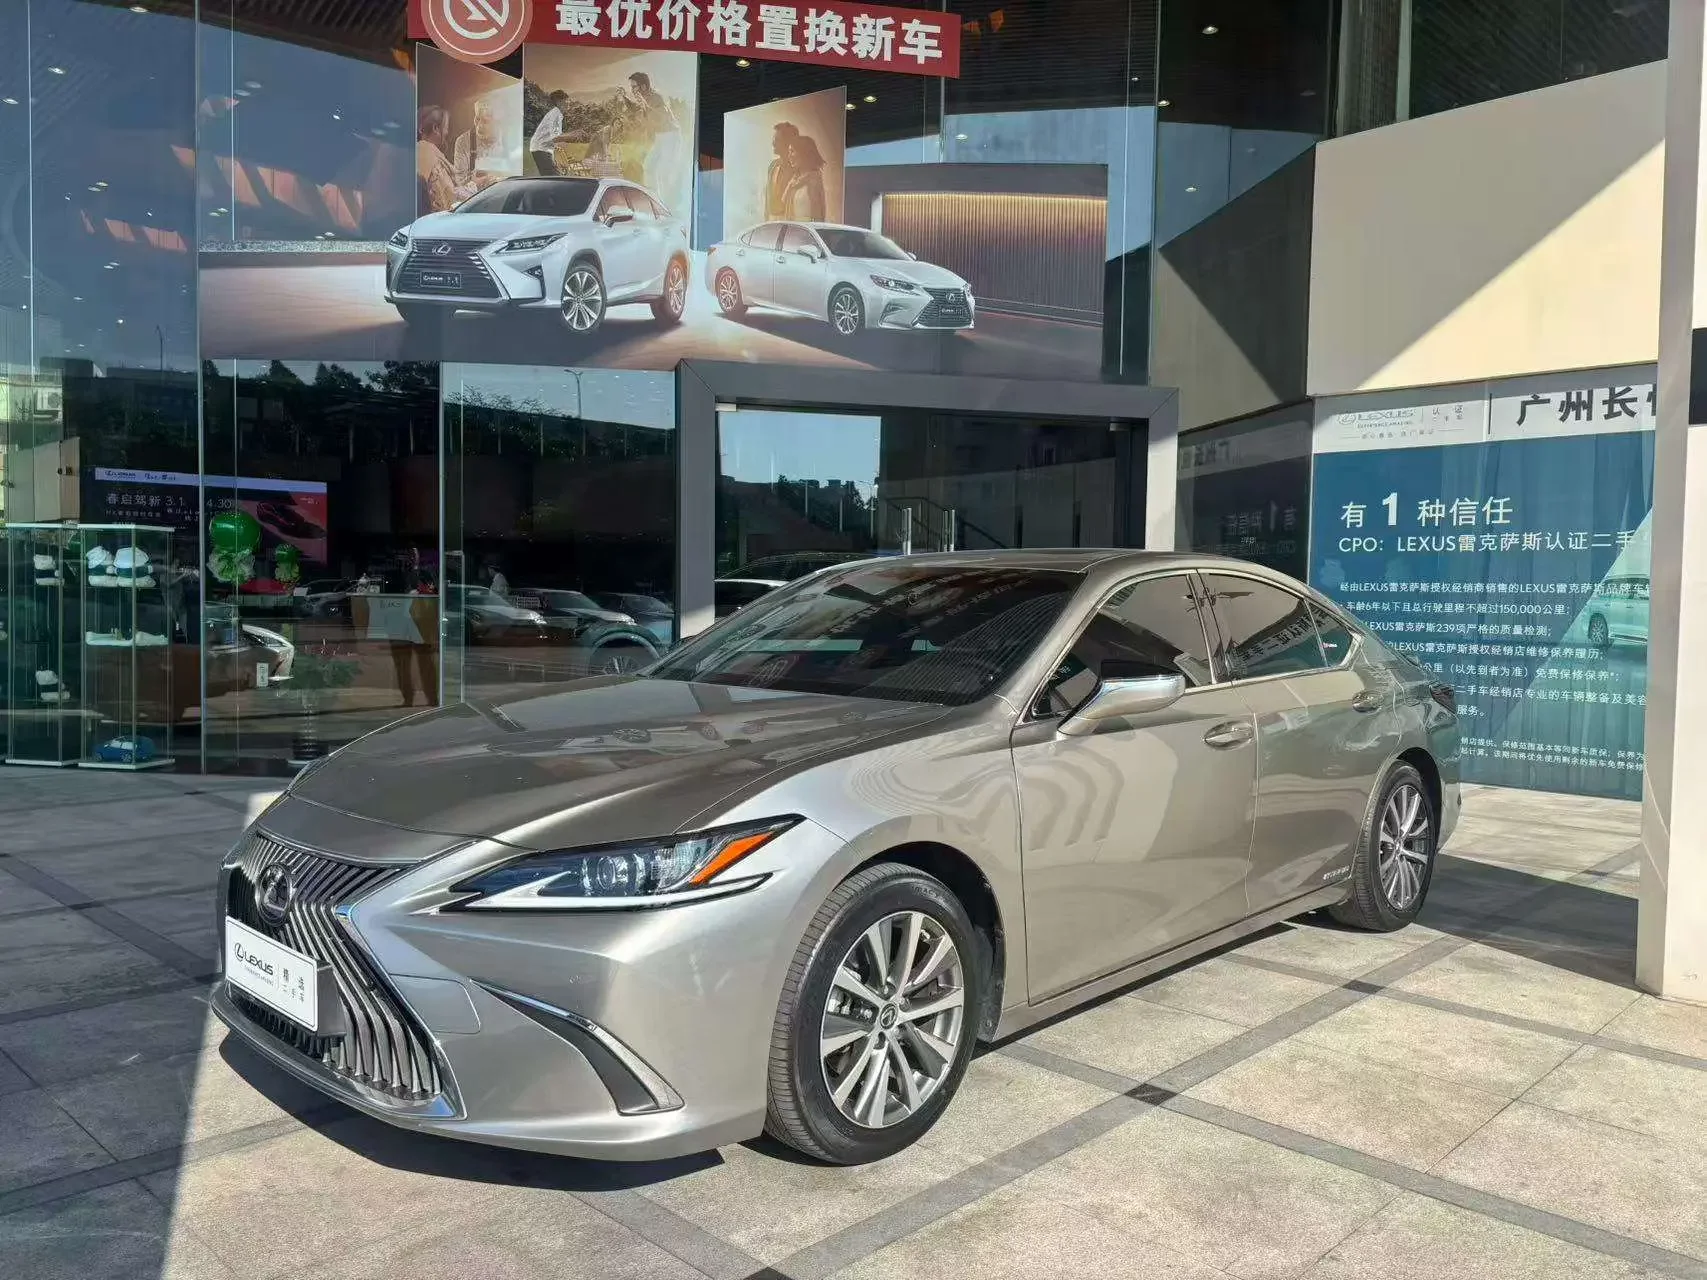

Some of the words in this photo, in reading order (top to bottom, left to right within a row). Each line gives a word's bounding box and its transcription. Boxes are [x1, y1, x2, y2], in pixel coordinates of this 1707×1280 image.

[556, 0, 943, 63] 最优价格置换新车
[1341, 501, 1367, 528] 有
[1382, 492, 1398, 526] 1
[1417, 496, 1513, 527] 种信任
[1420, 662, 1619, 682] 公里（以先到者为准）免费保修保养；
[1452, 684, 1647, 706] 二手车经销店专业的车辆整备及美容
[244, 951, 274, 976] LEXUS
